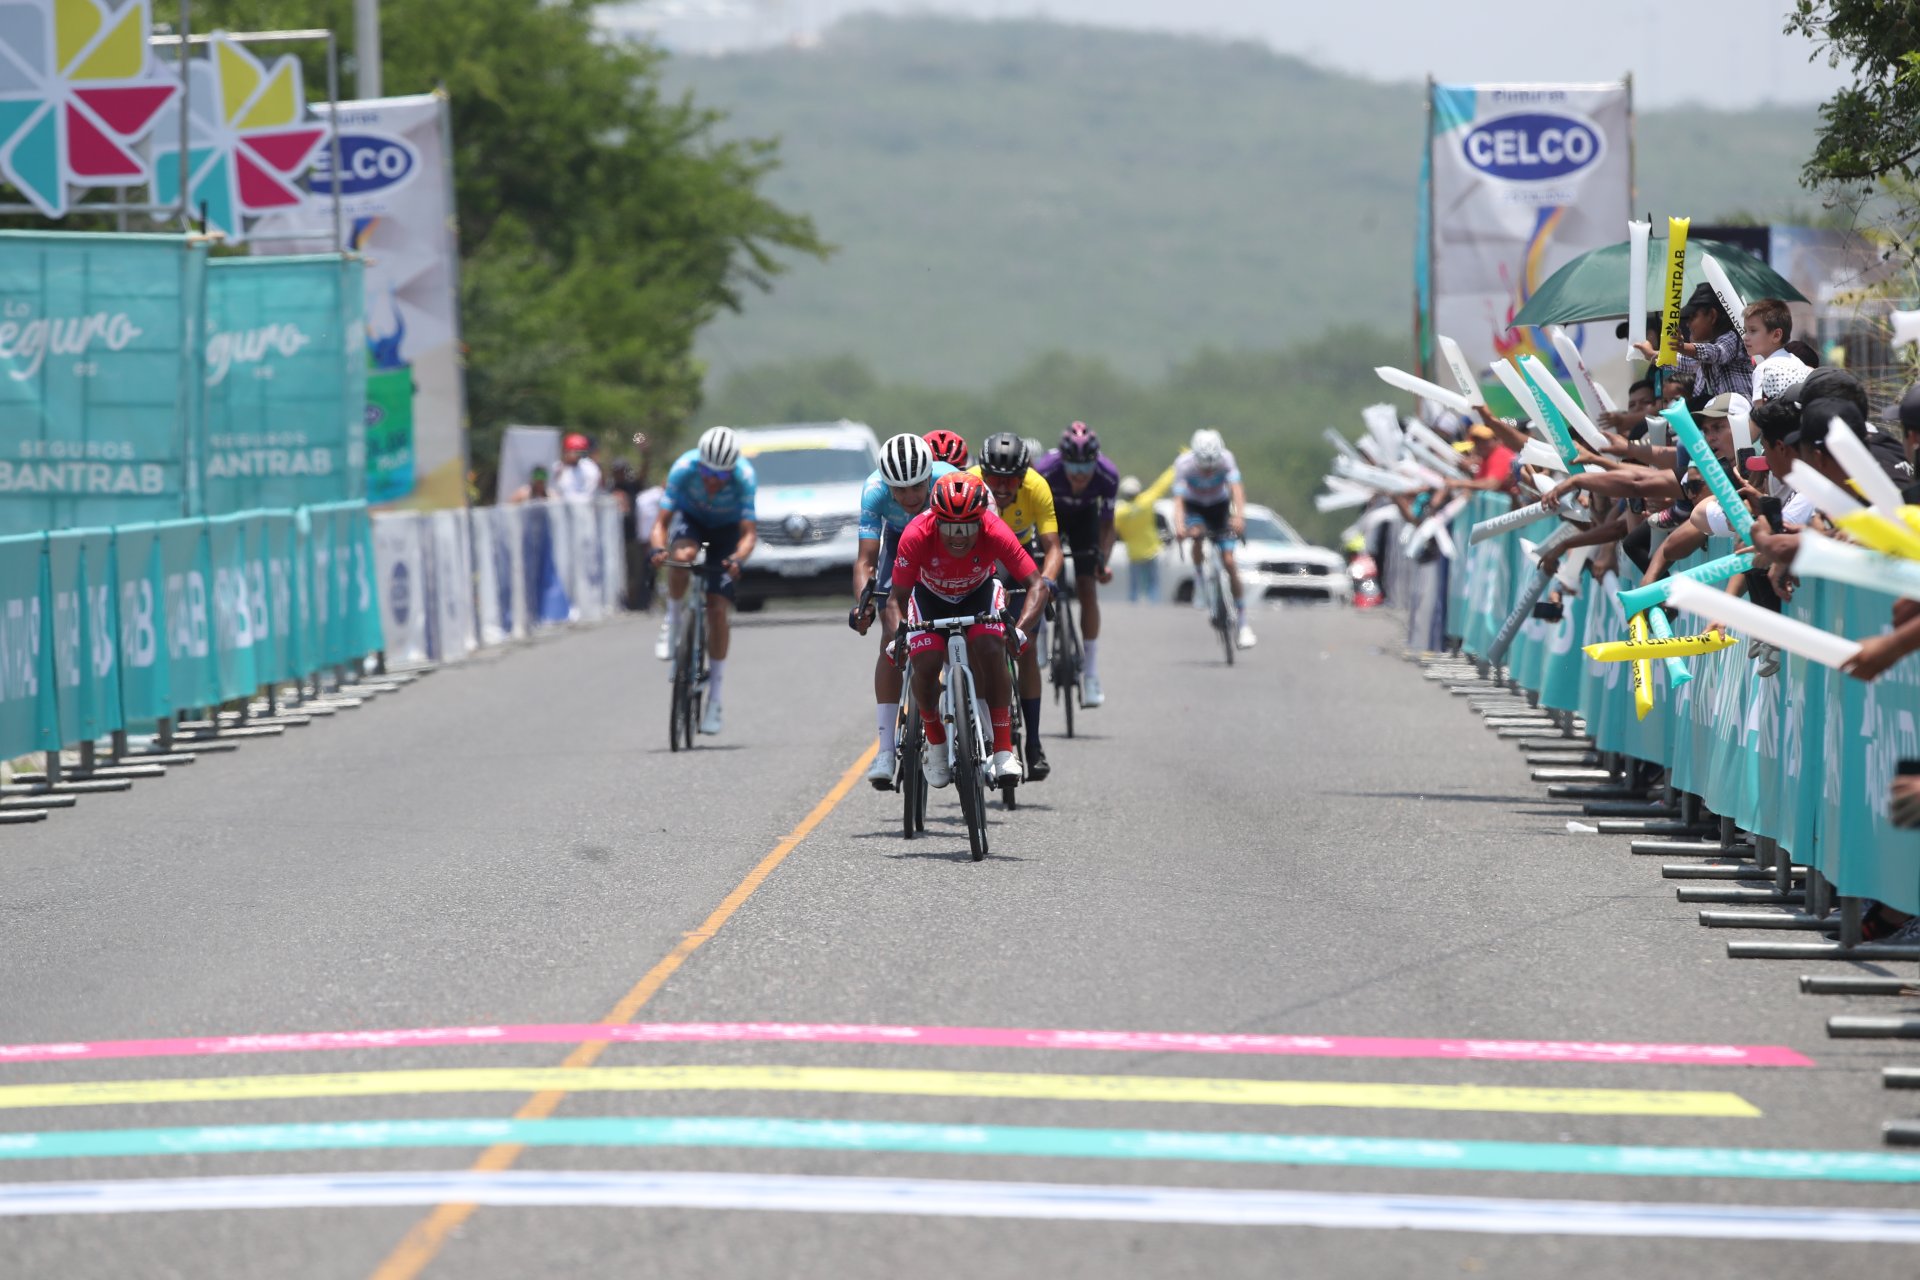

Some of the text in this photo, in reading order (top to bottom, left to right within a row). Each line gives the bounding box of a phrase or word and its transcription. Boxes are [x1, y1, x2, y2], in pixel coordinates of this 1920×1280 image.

[1467, 127, 1593, 167] CELCO
[1669, 249, 1685, 319] BANTRAB
[0, 312, 143, 381] eguro
[19, 439, 135, 460] SEGUROS
[0, 461, 165, 494] BANTRAB
[1692, 438, 1744, 517] BANTRAB
